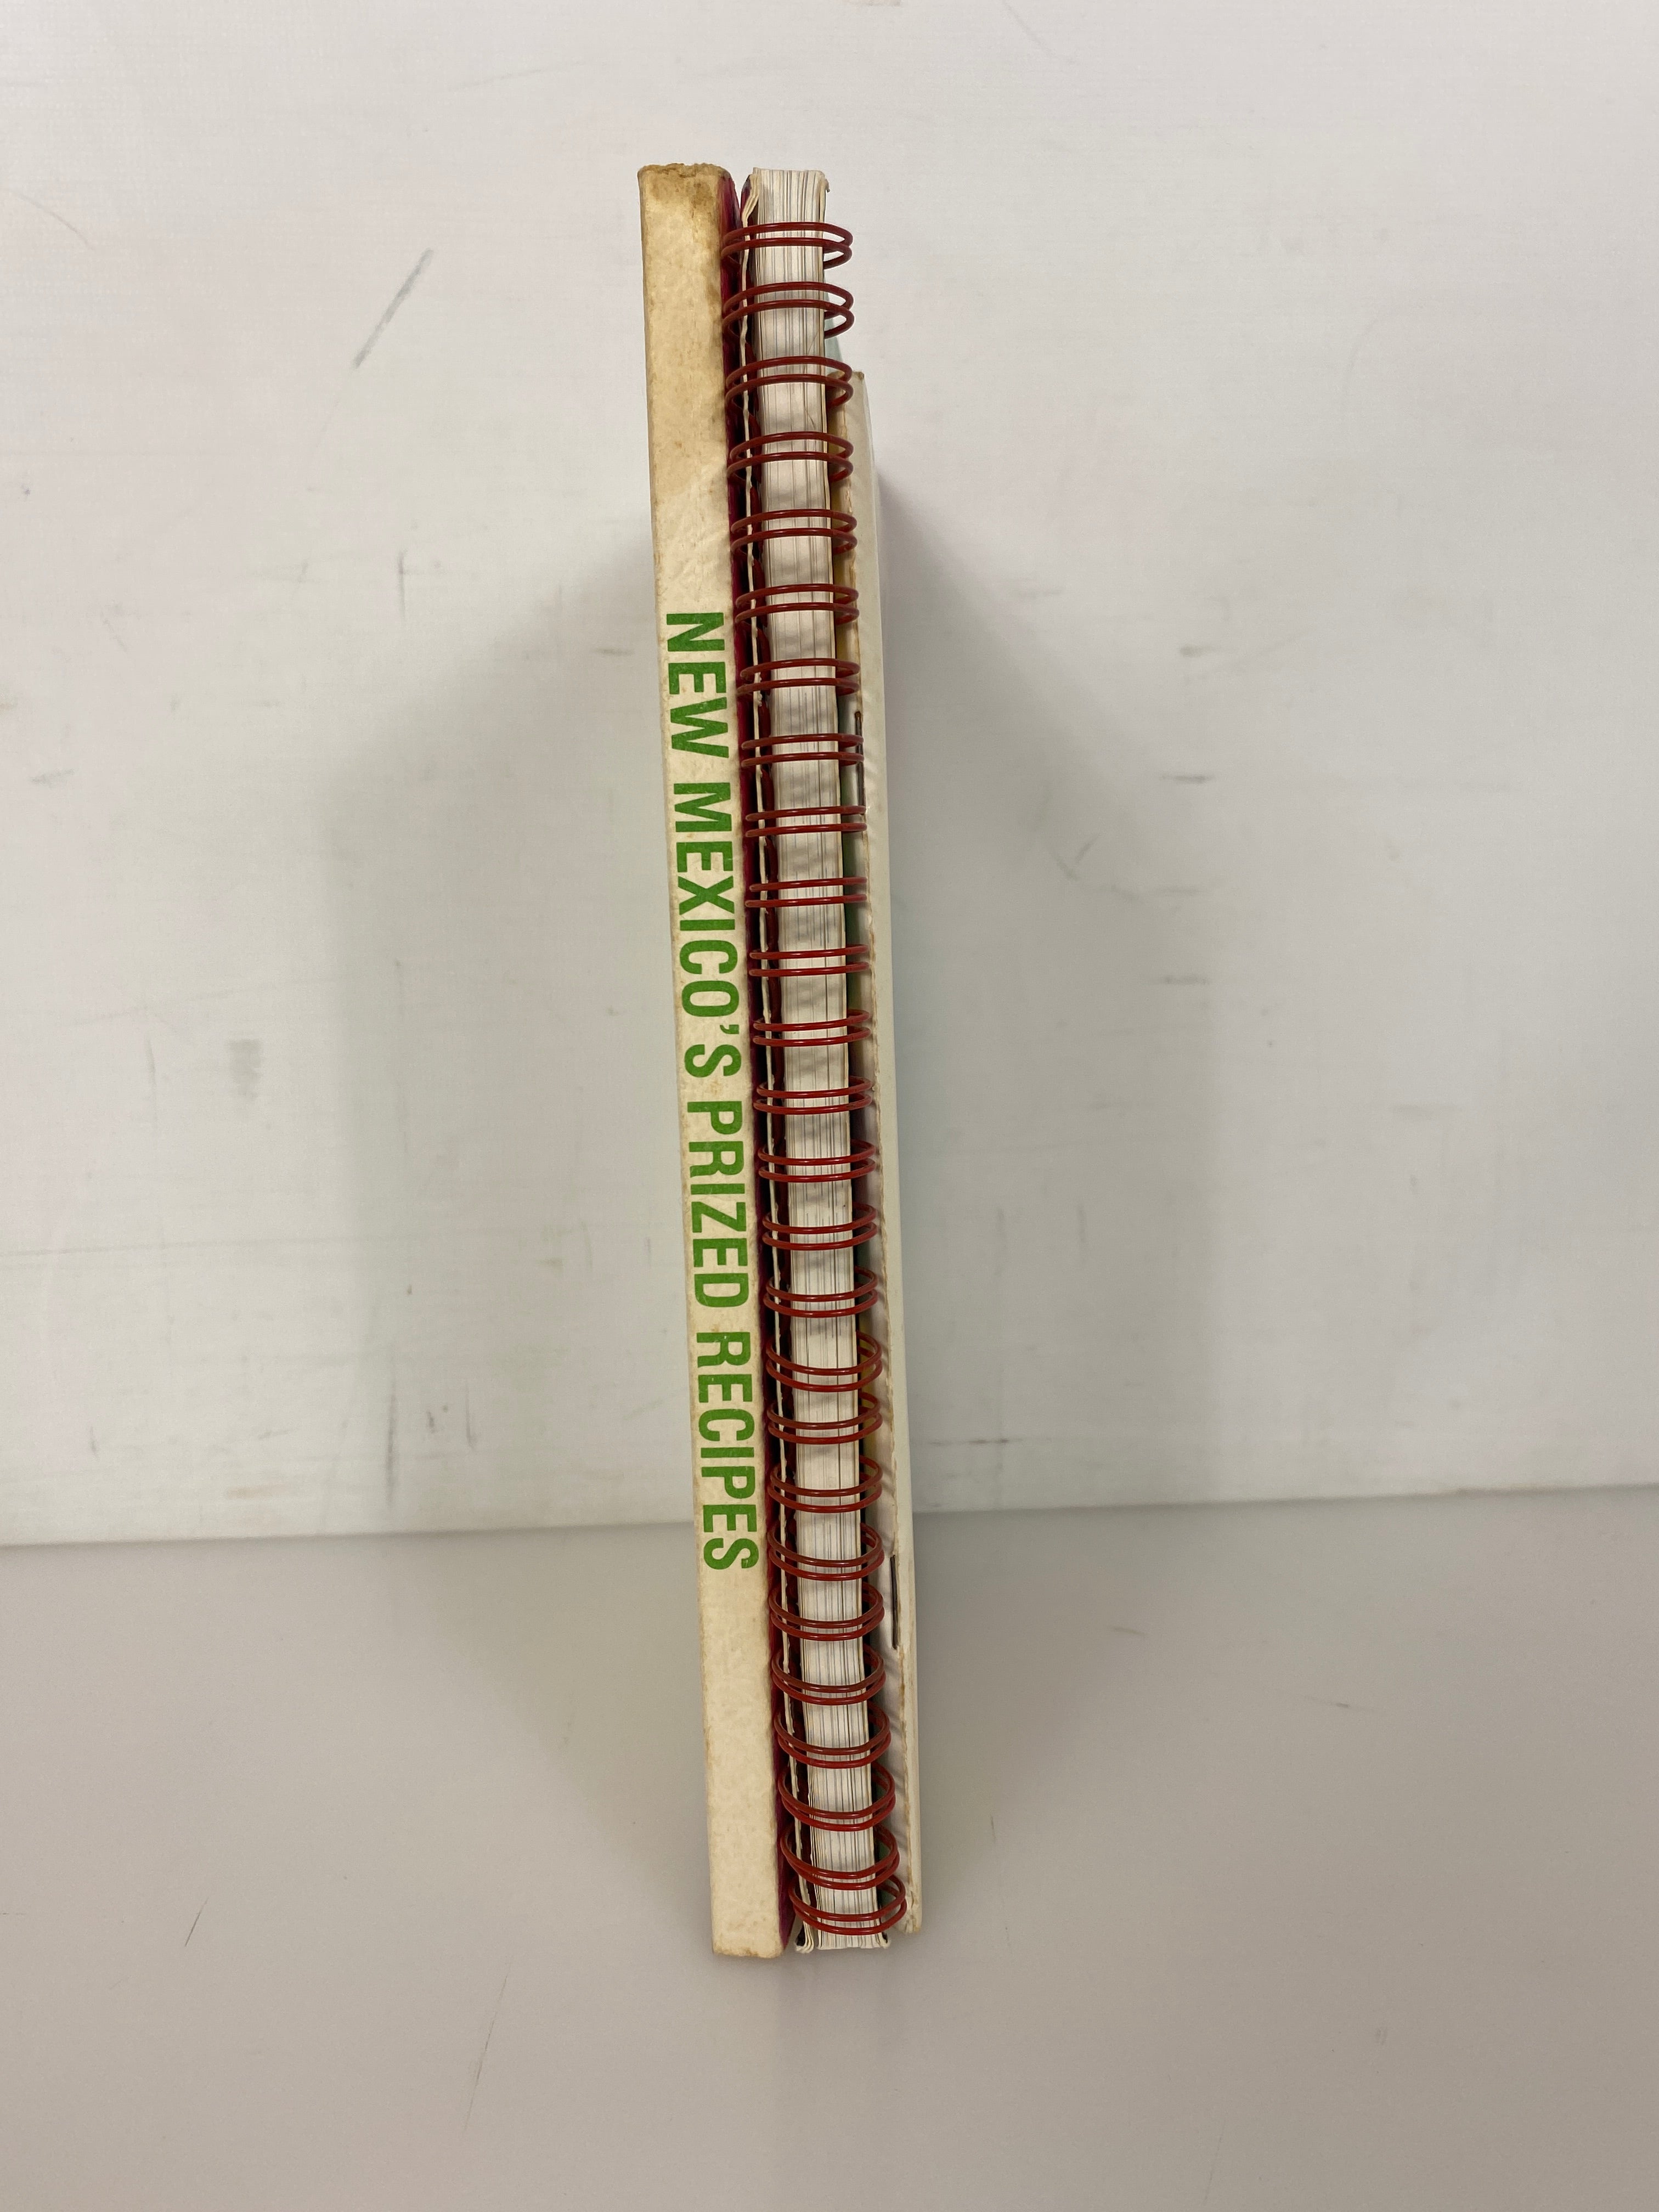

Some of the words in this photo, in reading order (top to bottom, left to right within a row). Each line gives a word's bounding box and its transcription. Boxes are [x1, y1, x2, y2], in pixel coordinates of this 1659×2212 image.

[666, 612, 729, 758] NEW
[674, 782, 742, 1078] MEXICO'S
[687, 1101, 750, 1308] PRIZED
[696, 1332, 759, 1571] RECIPES
